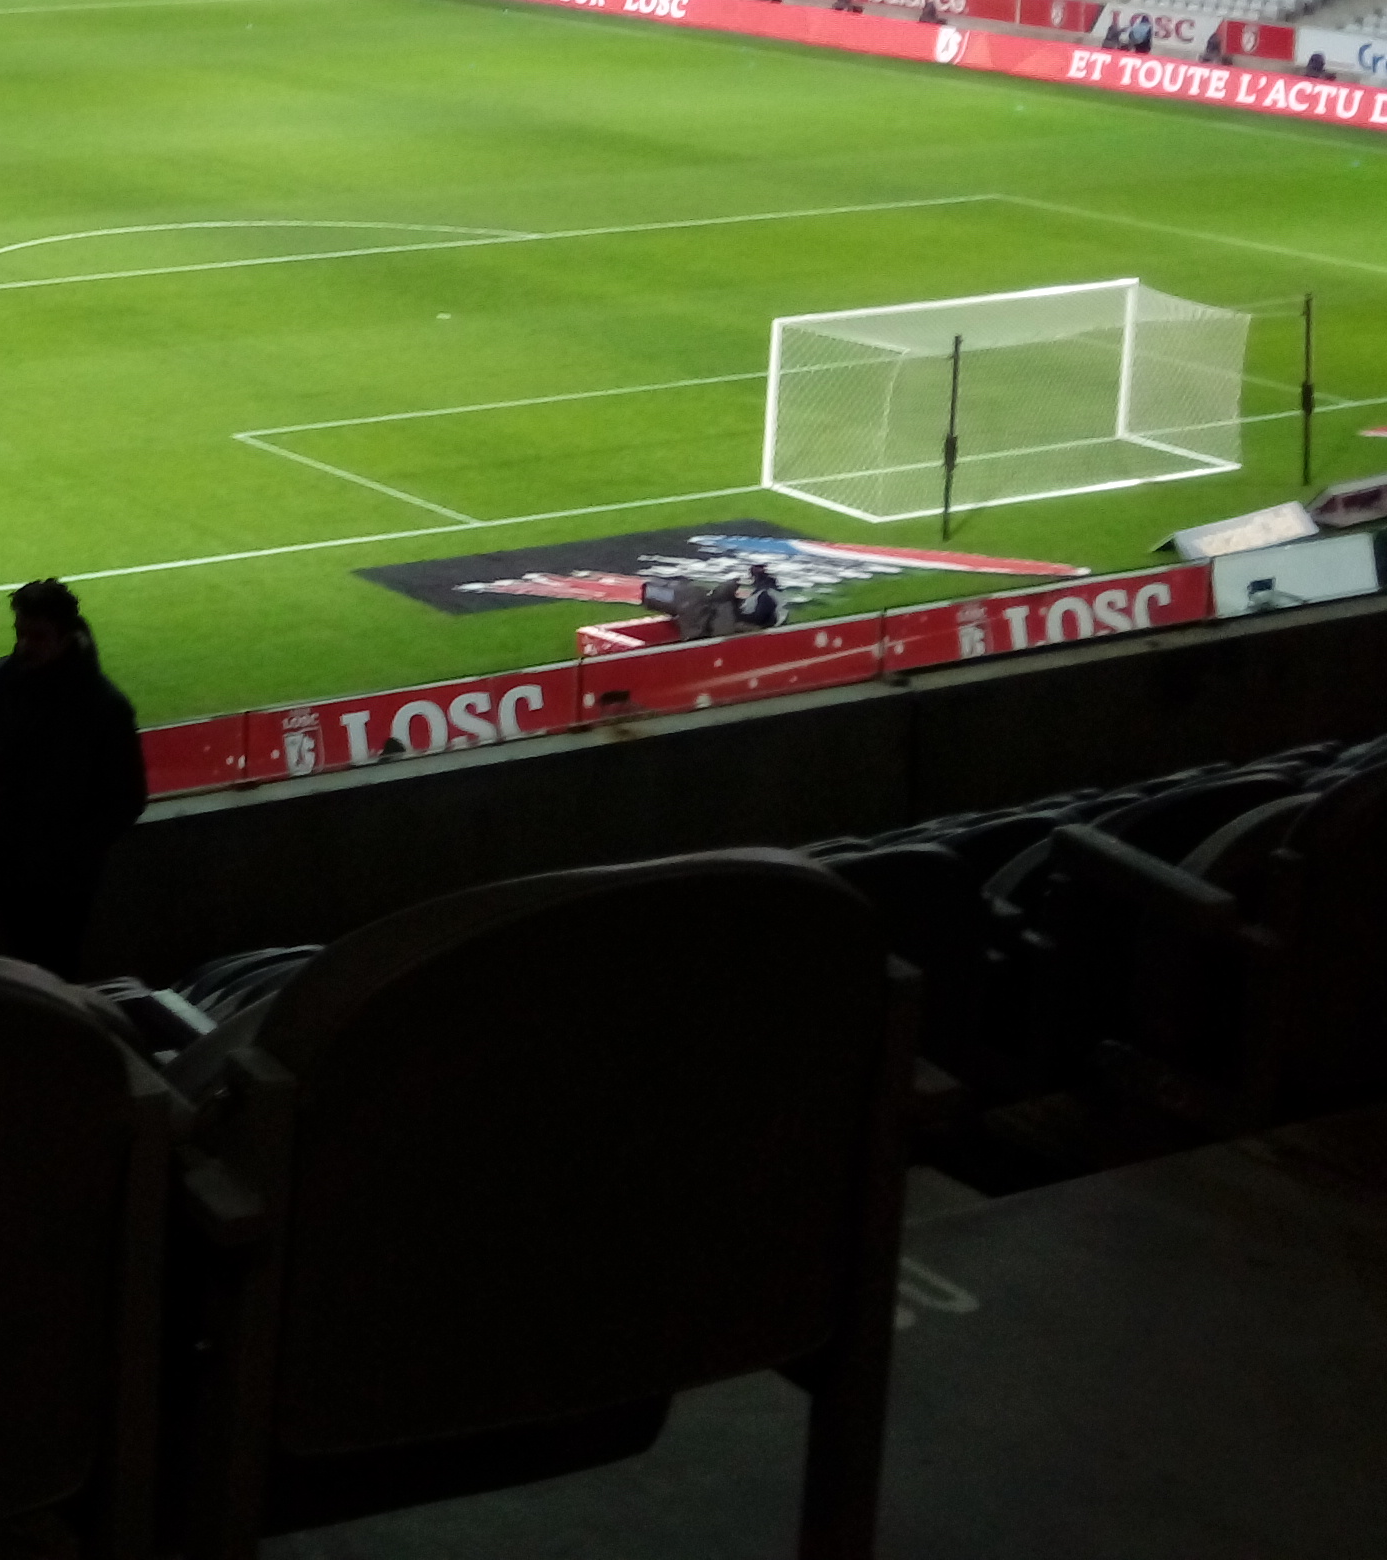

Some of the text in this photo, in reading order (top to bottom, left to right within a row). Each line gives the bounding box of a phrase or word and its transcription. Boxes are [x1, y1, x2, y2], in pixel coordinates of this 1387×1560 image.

[1066, 50, 1112, 82] ET
[1119, 57, 1231, 101] TOUTE
[1234, 73, 1365, 119] L'ACTU
[1002, 582, 1172, 651] LOSC
[339, 685, 545, 766] LOSC
